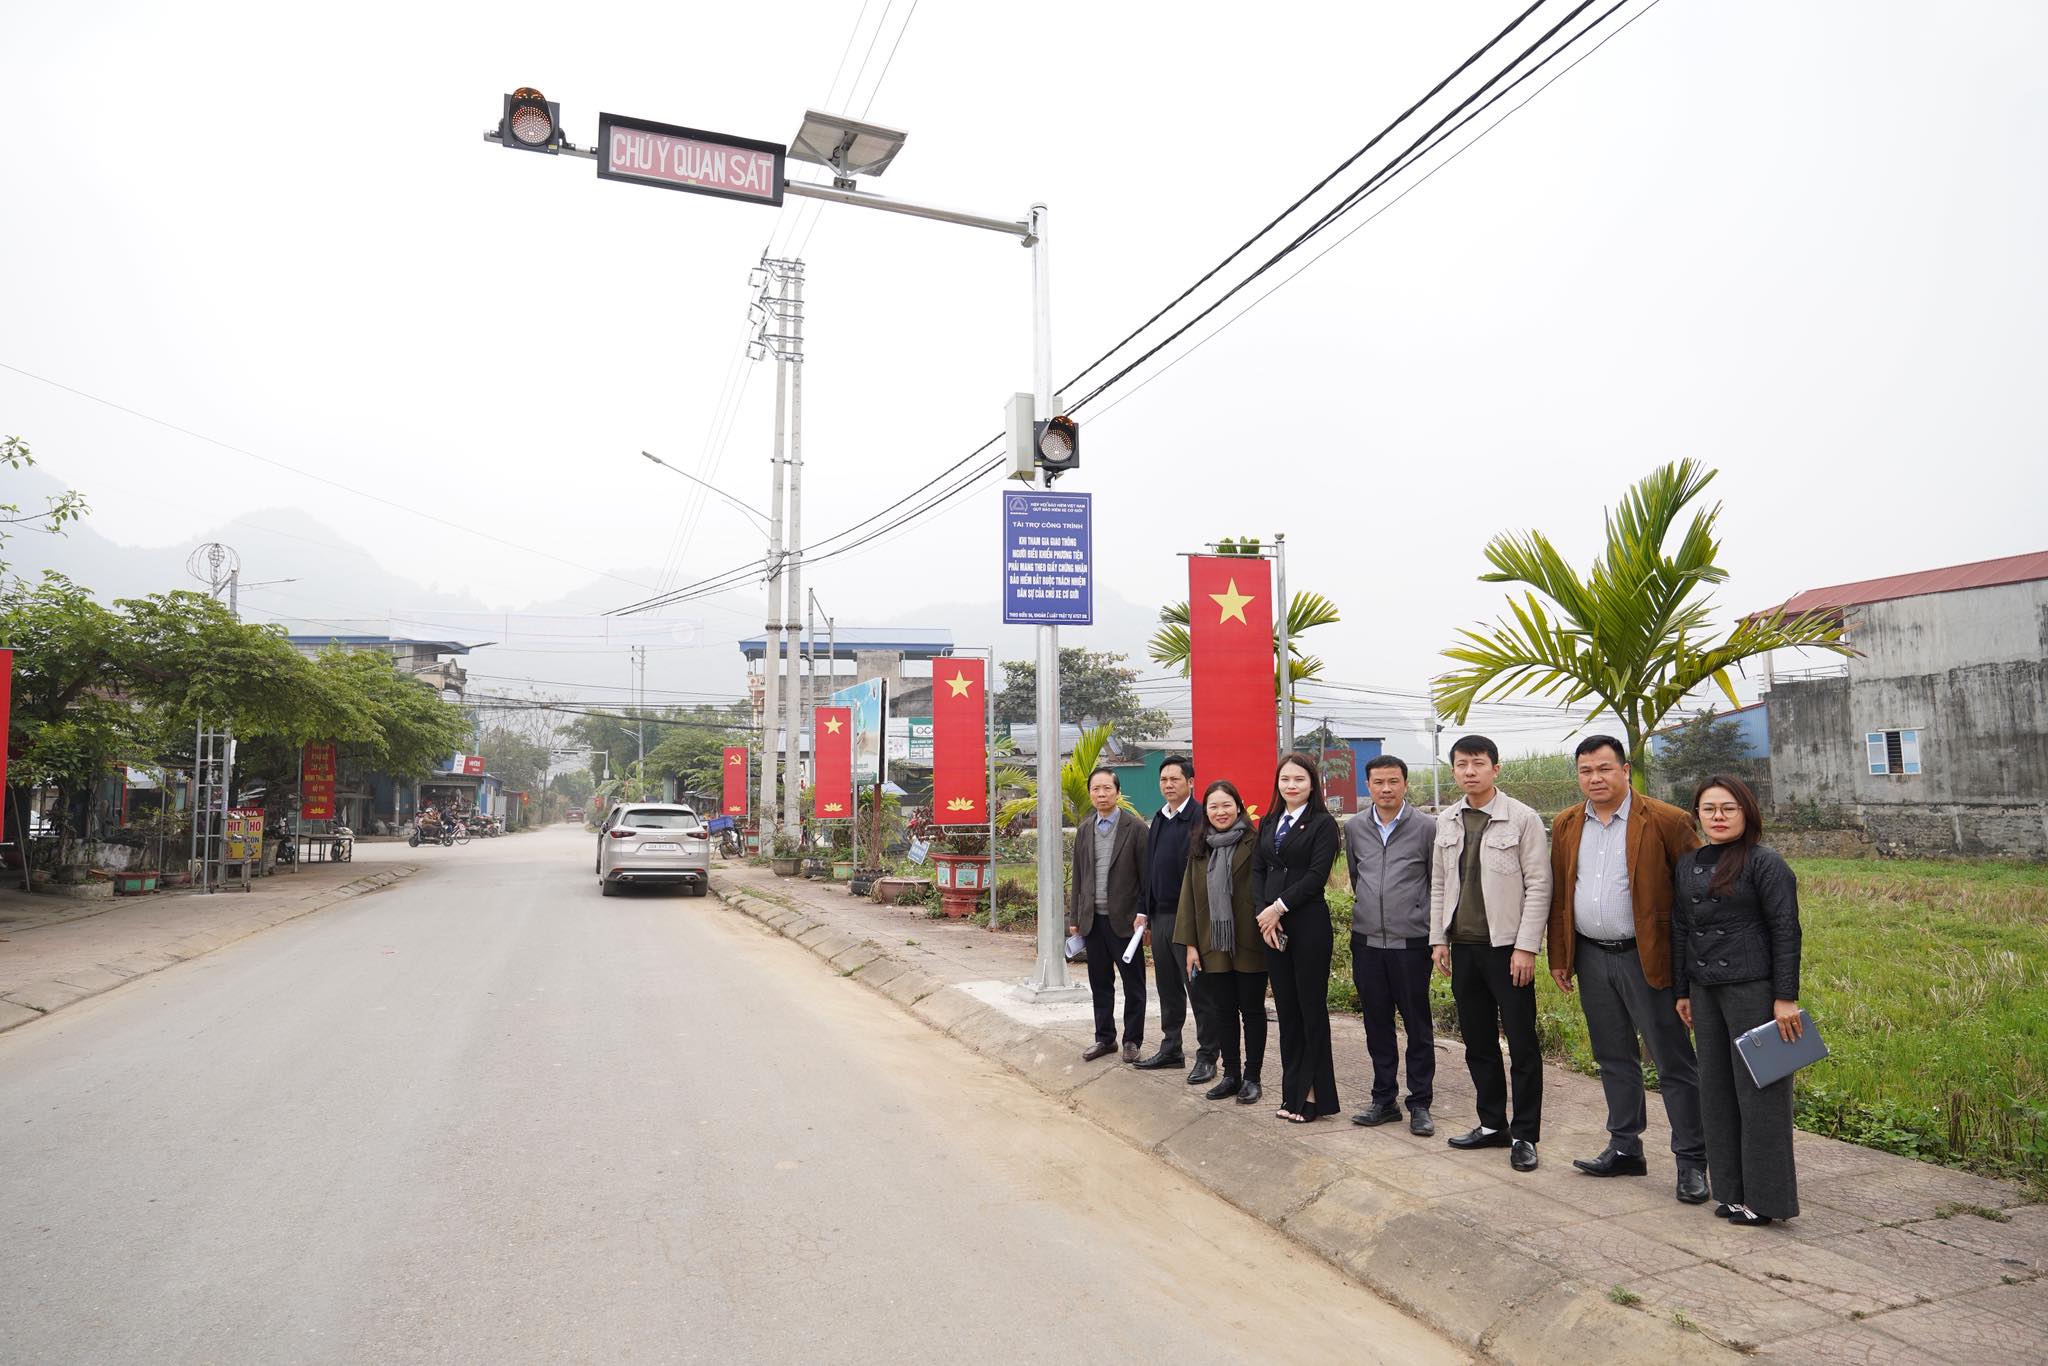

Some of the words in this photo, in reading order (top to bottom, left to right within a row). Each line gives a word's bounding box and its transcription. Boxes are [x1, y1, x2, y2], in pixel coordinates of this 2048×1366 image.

[613, 134, 653, 169] CHÚ
[656, 136, 669, 172] Ý
[673, 144, 726, 183] QUAN
[730, 153, 773, 191] SÁT
[1025, 521, 1040, 529] TRỢ
[1041, 521, 1062, 529] CÔNG
[1034, 562, 1046, 572] THEO
[1055, 589, 1062, 599] XE
